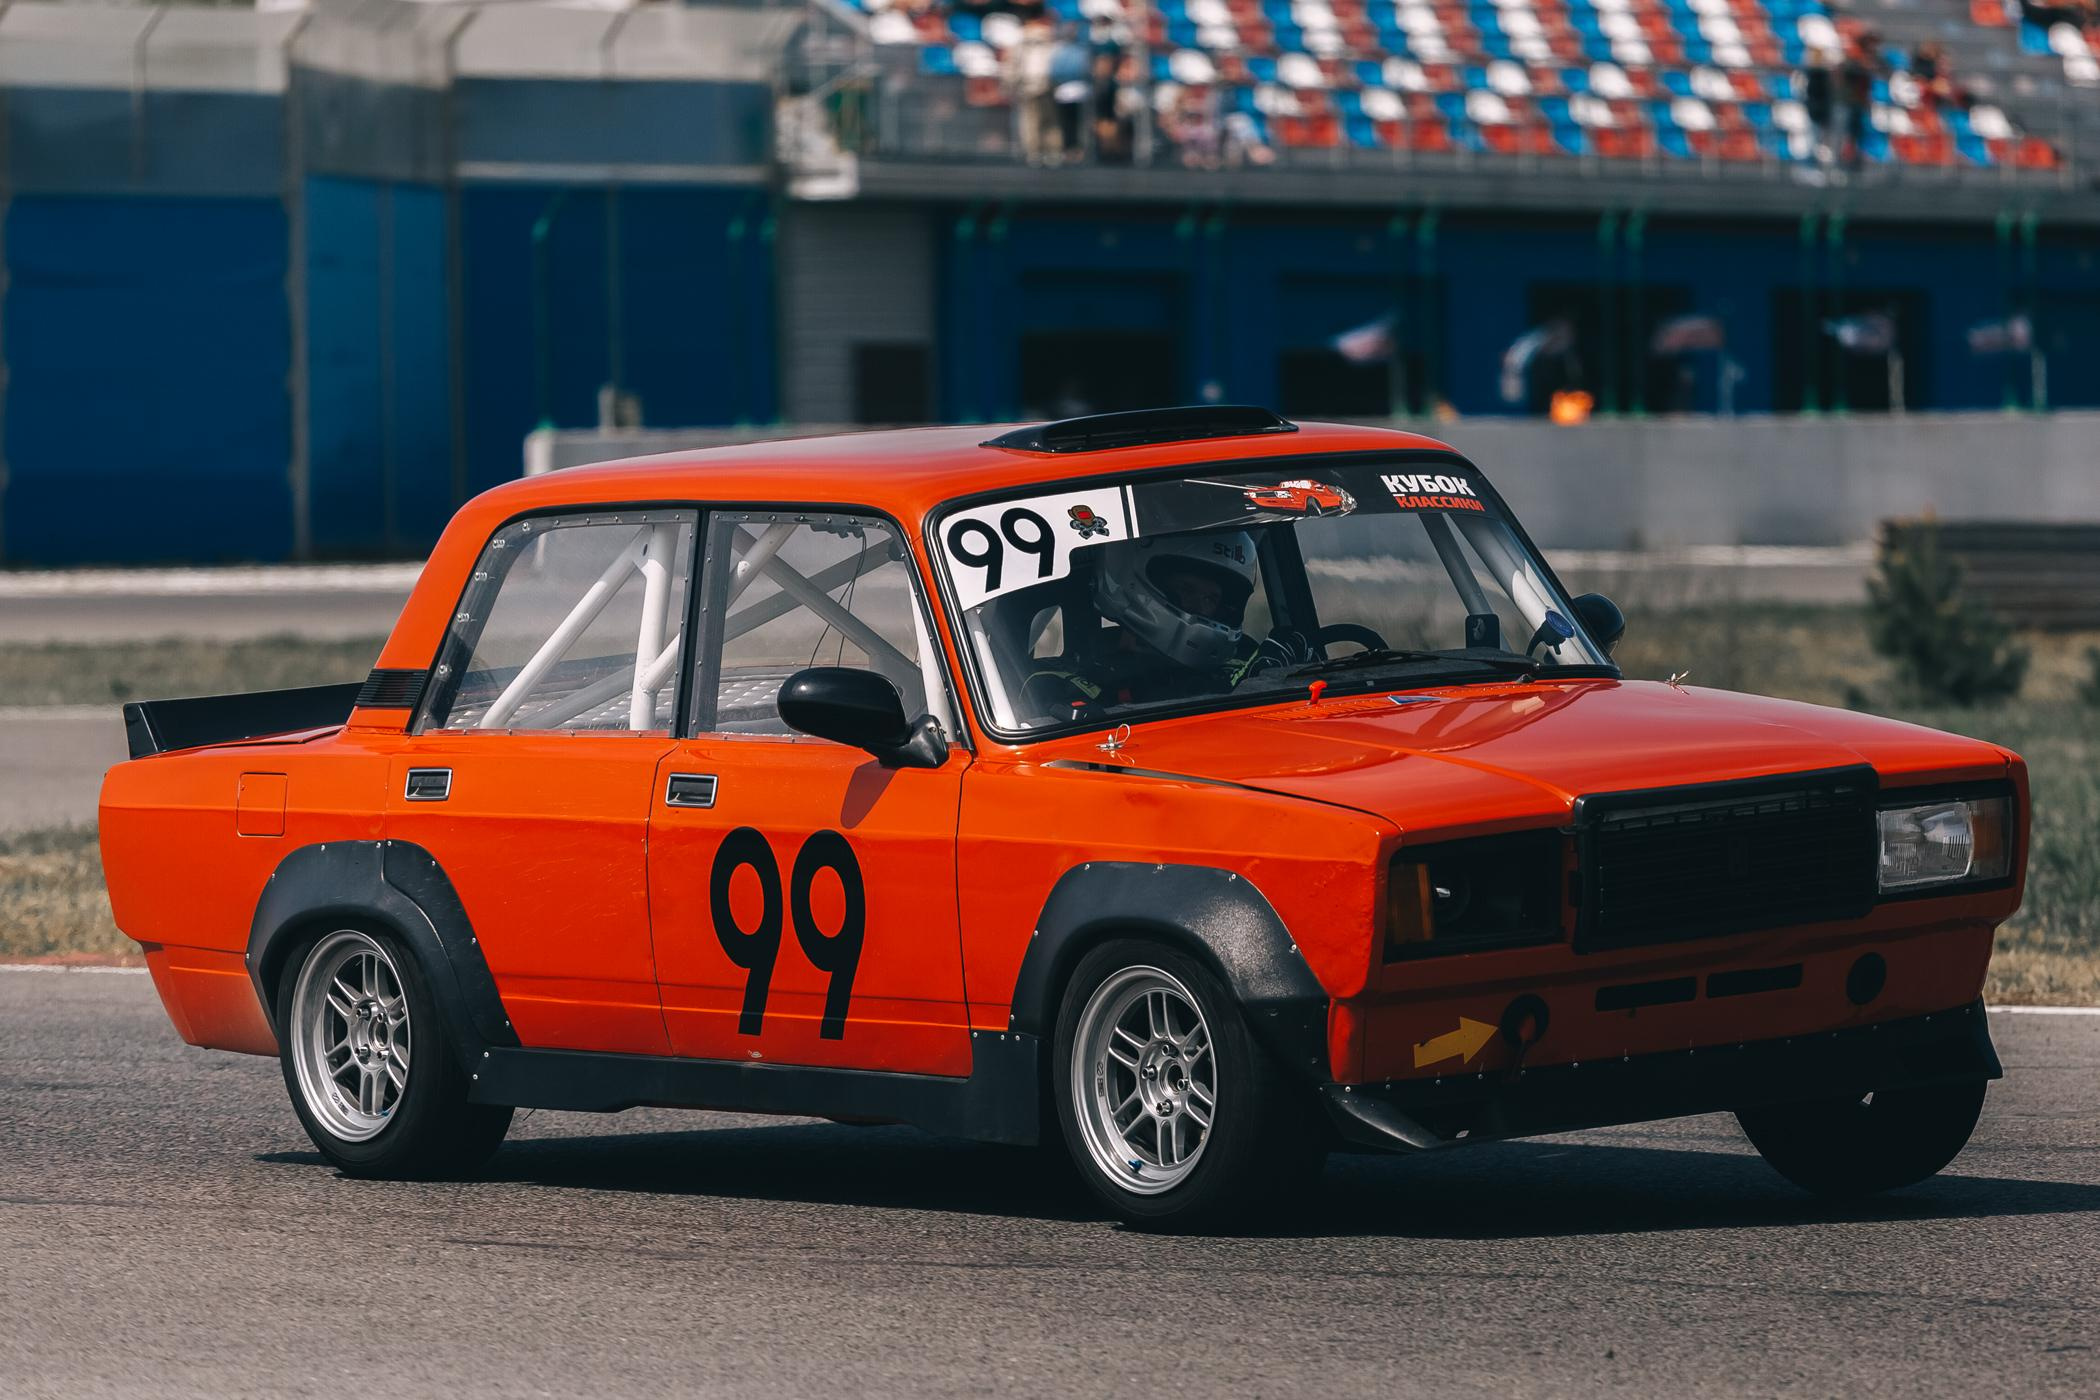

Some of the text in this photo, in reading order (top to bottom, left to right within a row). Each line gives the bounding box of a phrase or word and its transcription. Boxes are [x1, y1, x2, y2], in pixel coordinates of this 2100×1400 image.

[1380, 475, 1476, 496] КУБОК
[1395, 496, 1485, 511] КЛАССИКИ
[947, 507, 1055, 593] 99
[710, 826, 866, 1040] 99
